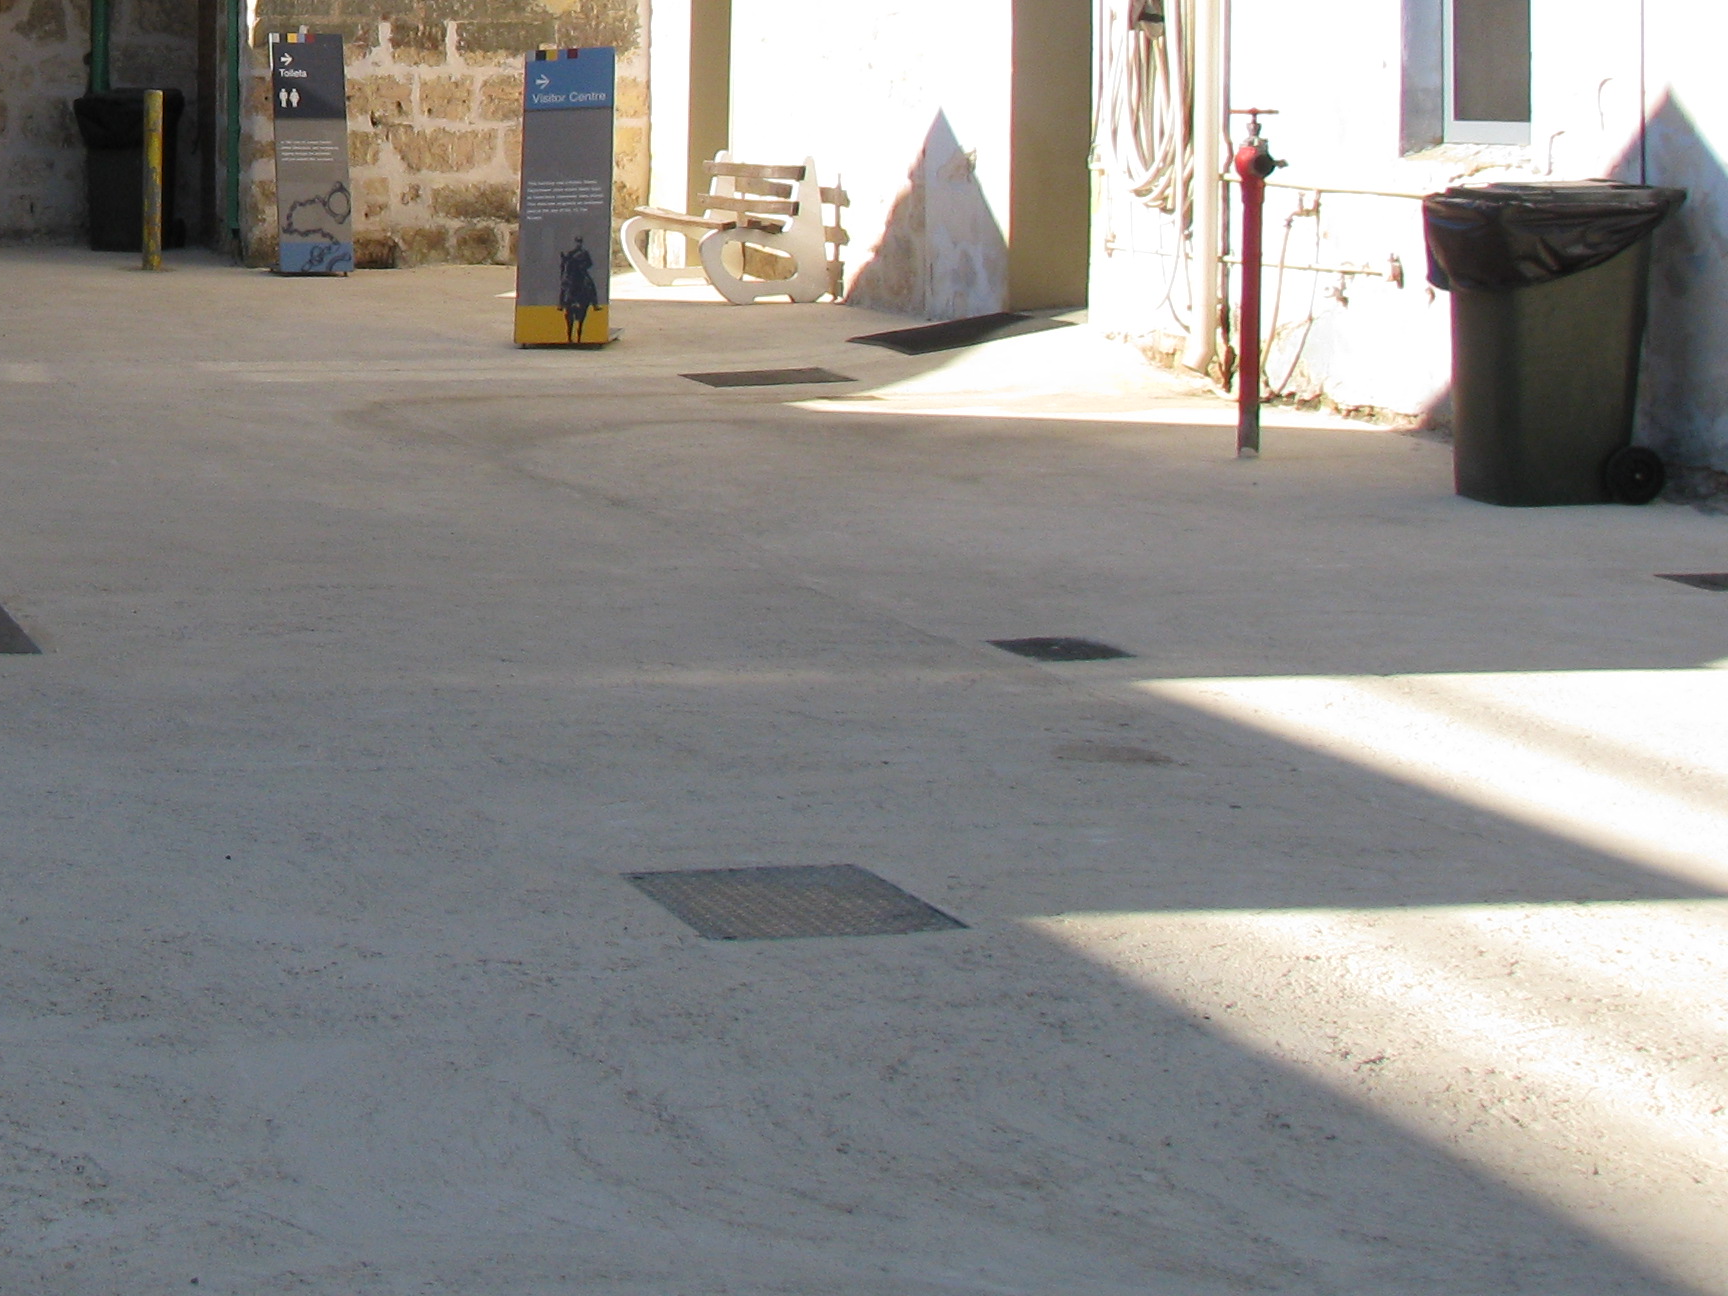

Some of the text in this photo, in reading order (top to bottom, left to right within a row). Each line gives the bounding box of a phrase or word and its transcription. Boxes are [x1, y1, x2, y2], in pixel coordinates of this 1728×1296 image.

[278, 68, 308, 78] Toilets
[532, 91, 607, 104] Visitor Centre
